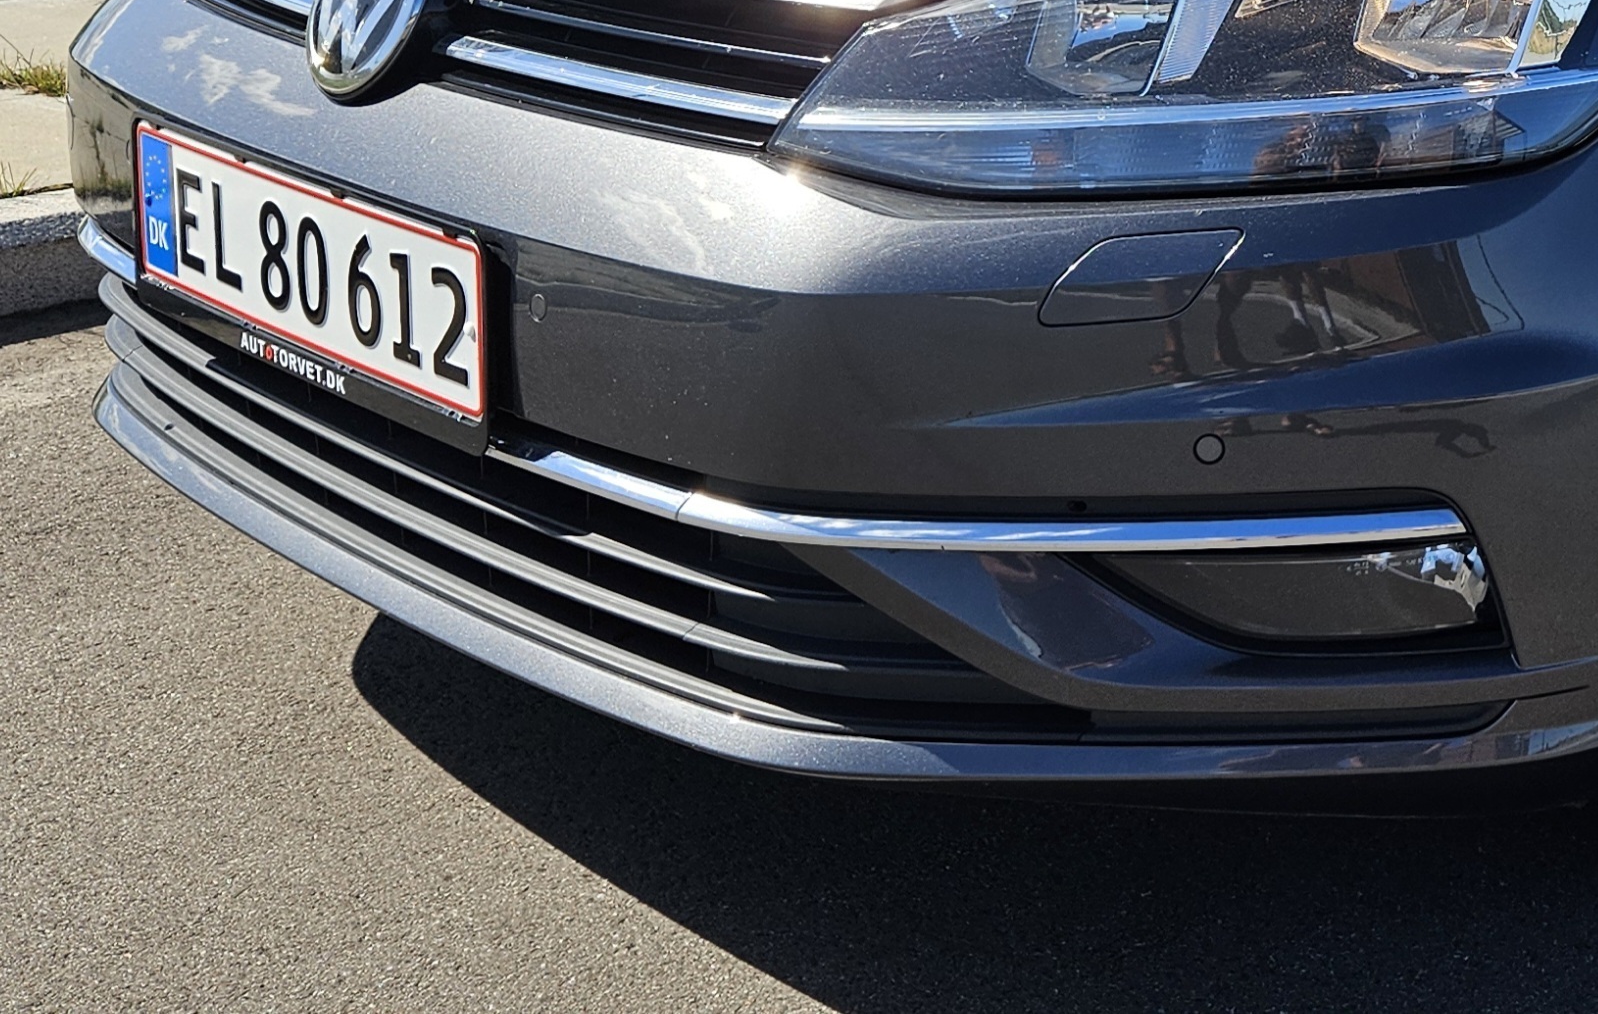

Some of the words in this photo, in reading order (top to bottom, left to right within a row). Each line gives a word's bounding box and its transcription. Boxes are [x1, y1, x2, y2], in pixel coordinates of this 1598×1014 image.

[148, 215, 170, 251] DK
[176, 168, 243, 293] EL
[258, 199, 329, 328] 80
[347, 234, 471, 388] 612
[240, 331, 347, 395] AUTOTORVET.DK
